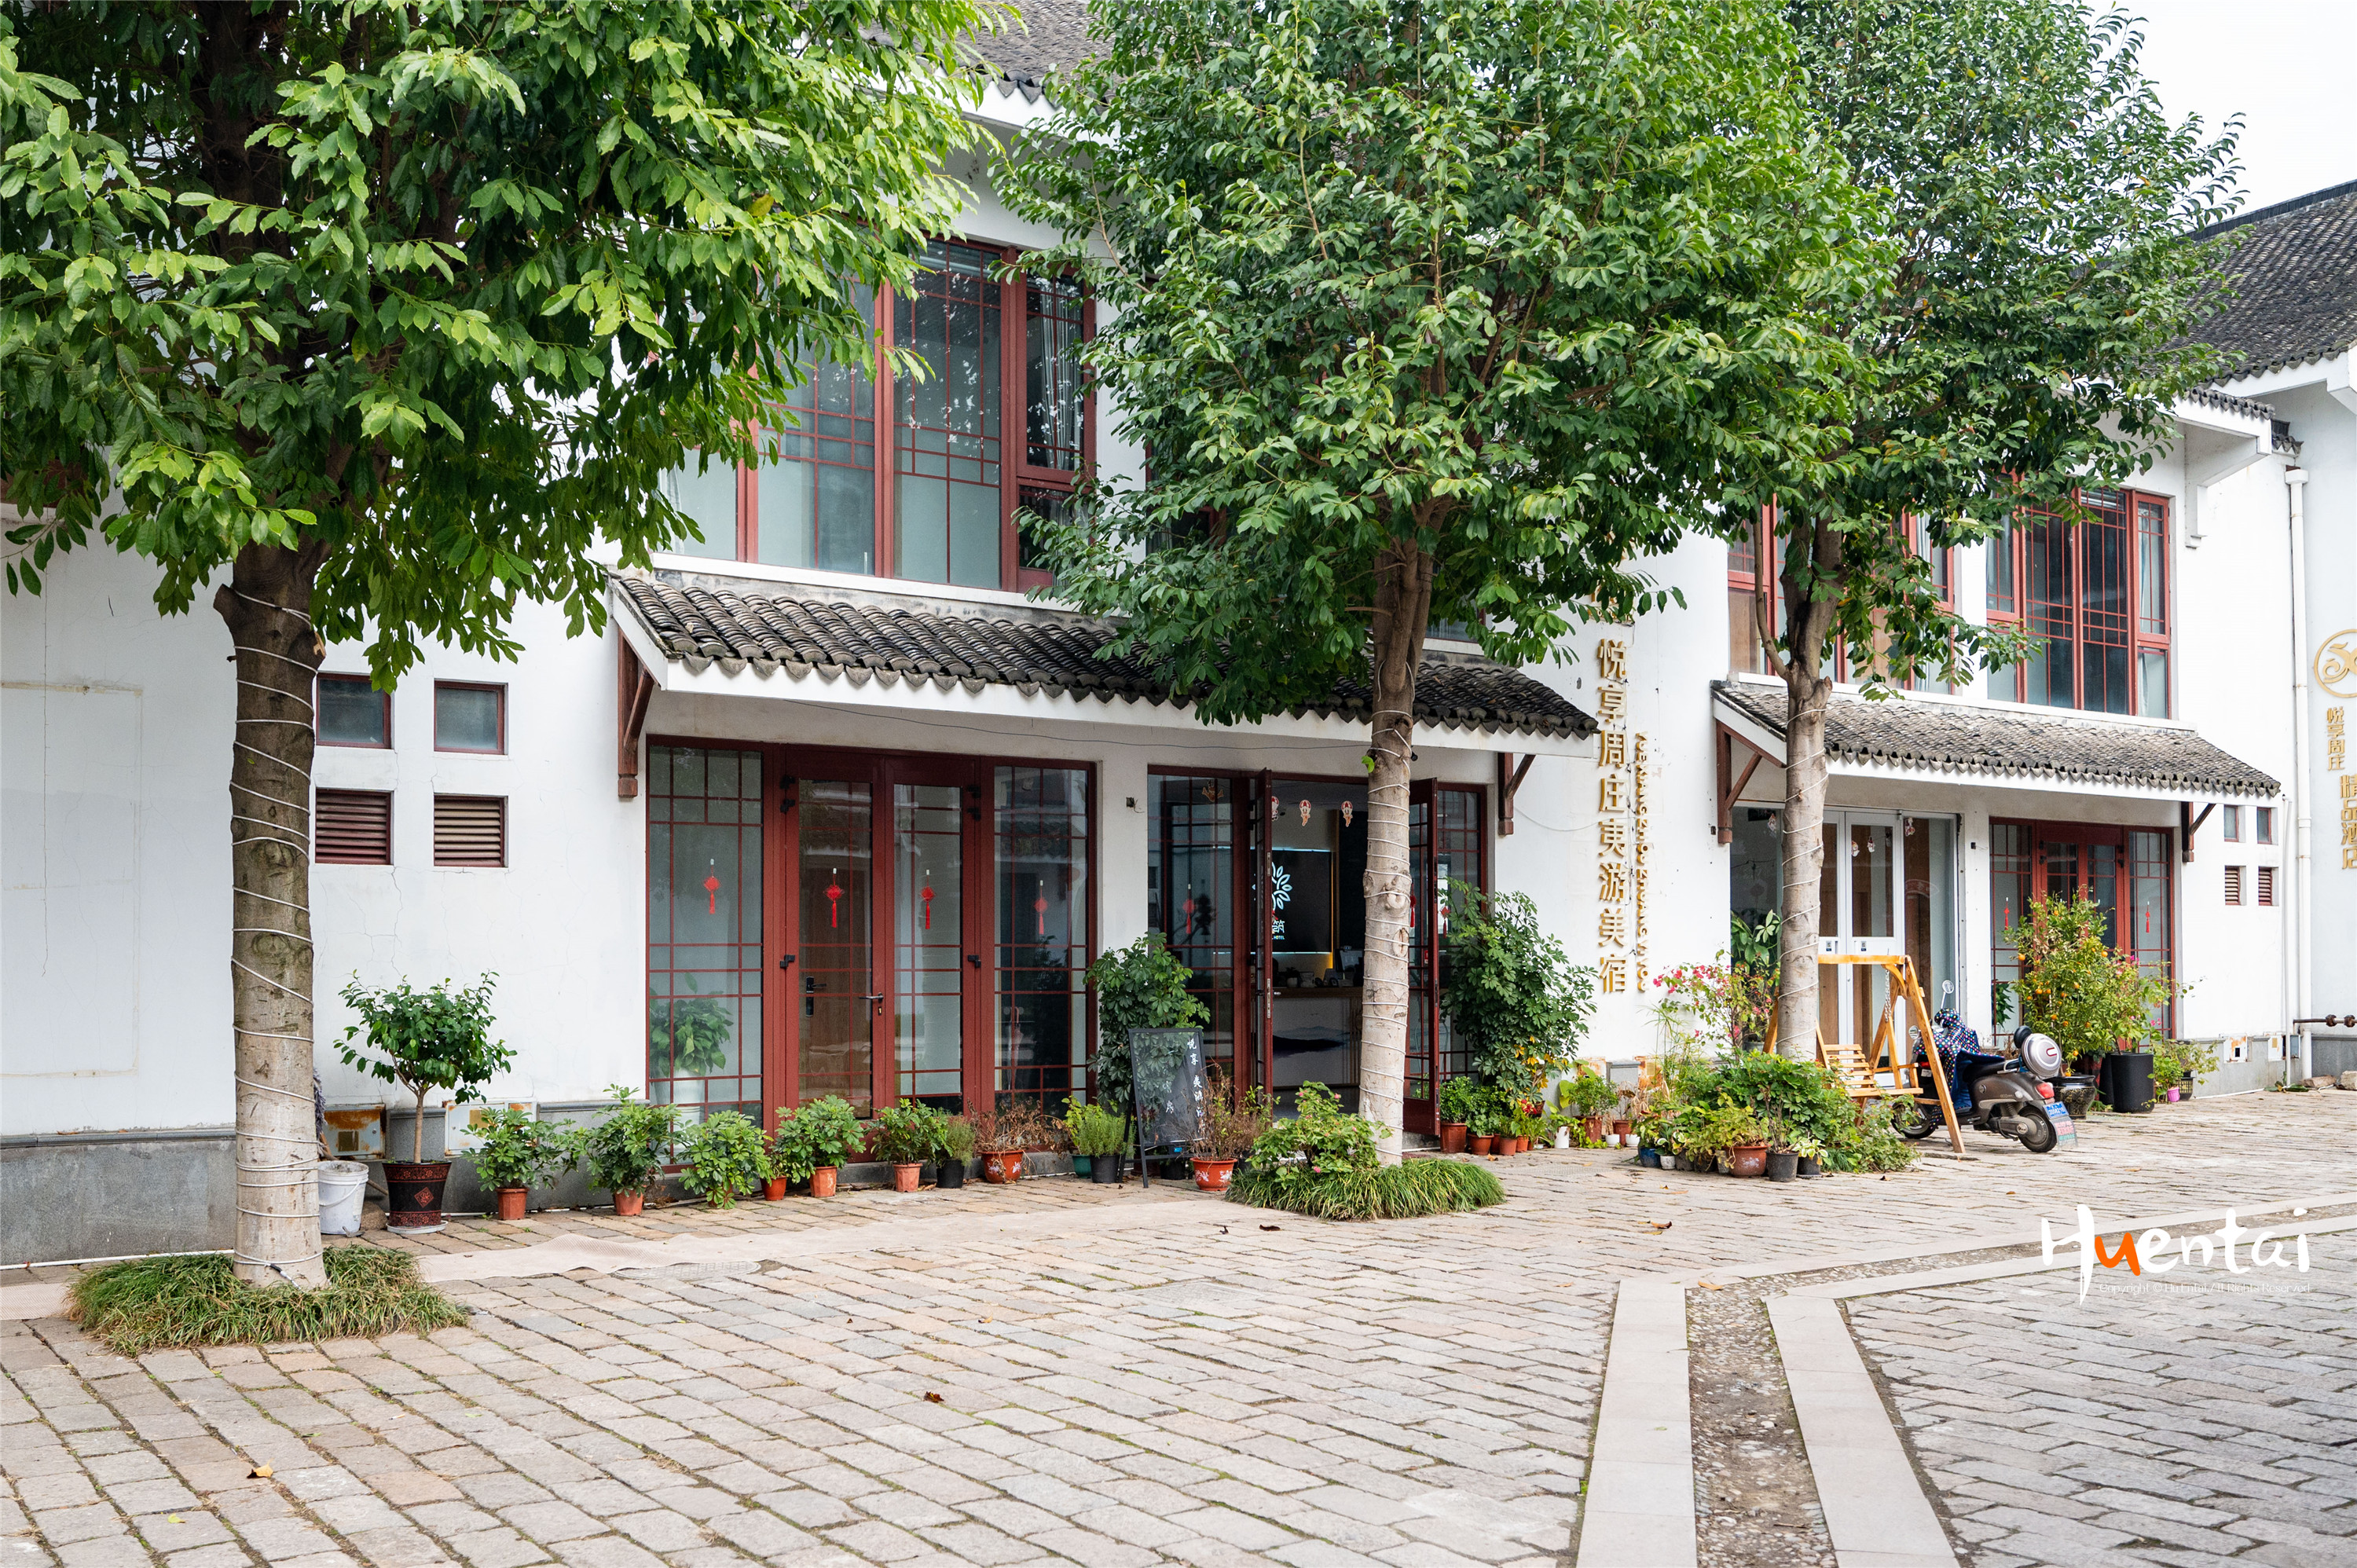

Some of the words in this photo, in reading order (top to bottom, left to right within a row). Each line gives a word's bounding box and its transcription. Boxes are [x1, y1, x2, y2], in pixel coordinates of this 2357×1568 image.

[1635, 731, 1648, 761] YUE
[2326, 706, 2345, 771] 悦享周庄
[1597, 637, 1629, 993] 悦享周庄夷游美宿
[1636, 764, 1648, 815] XIANG
[1637, 958, 1649, 993] YOU
